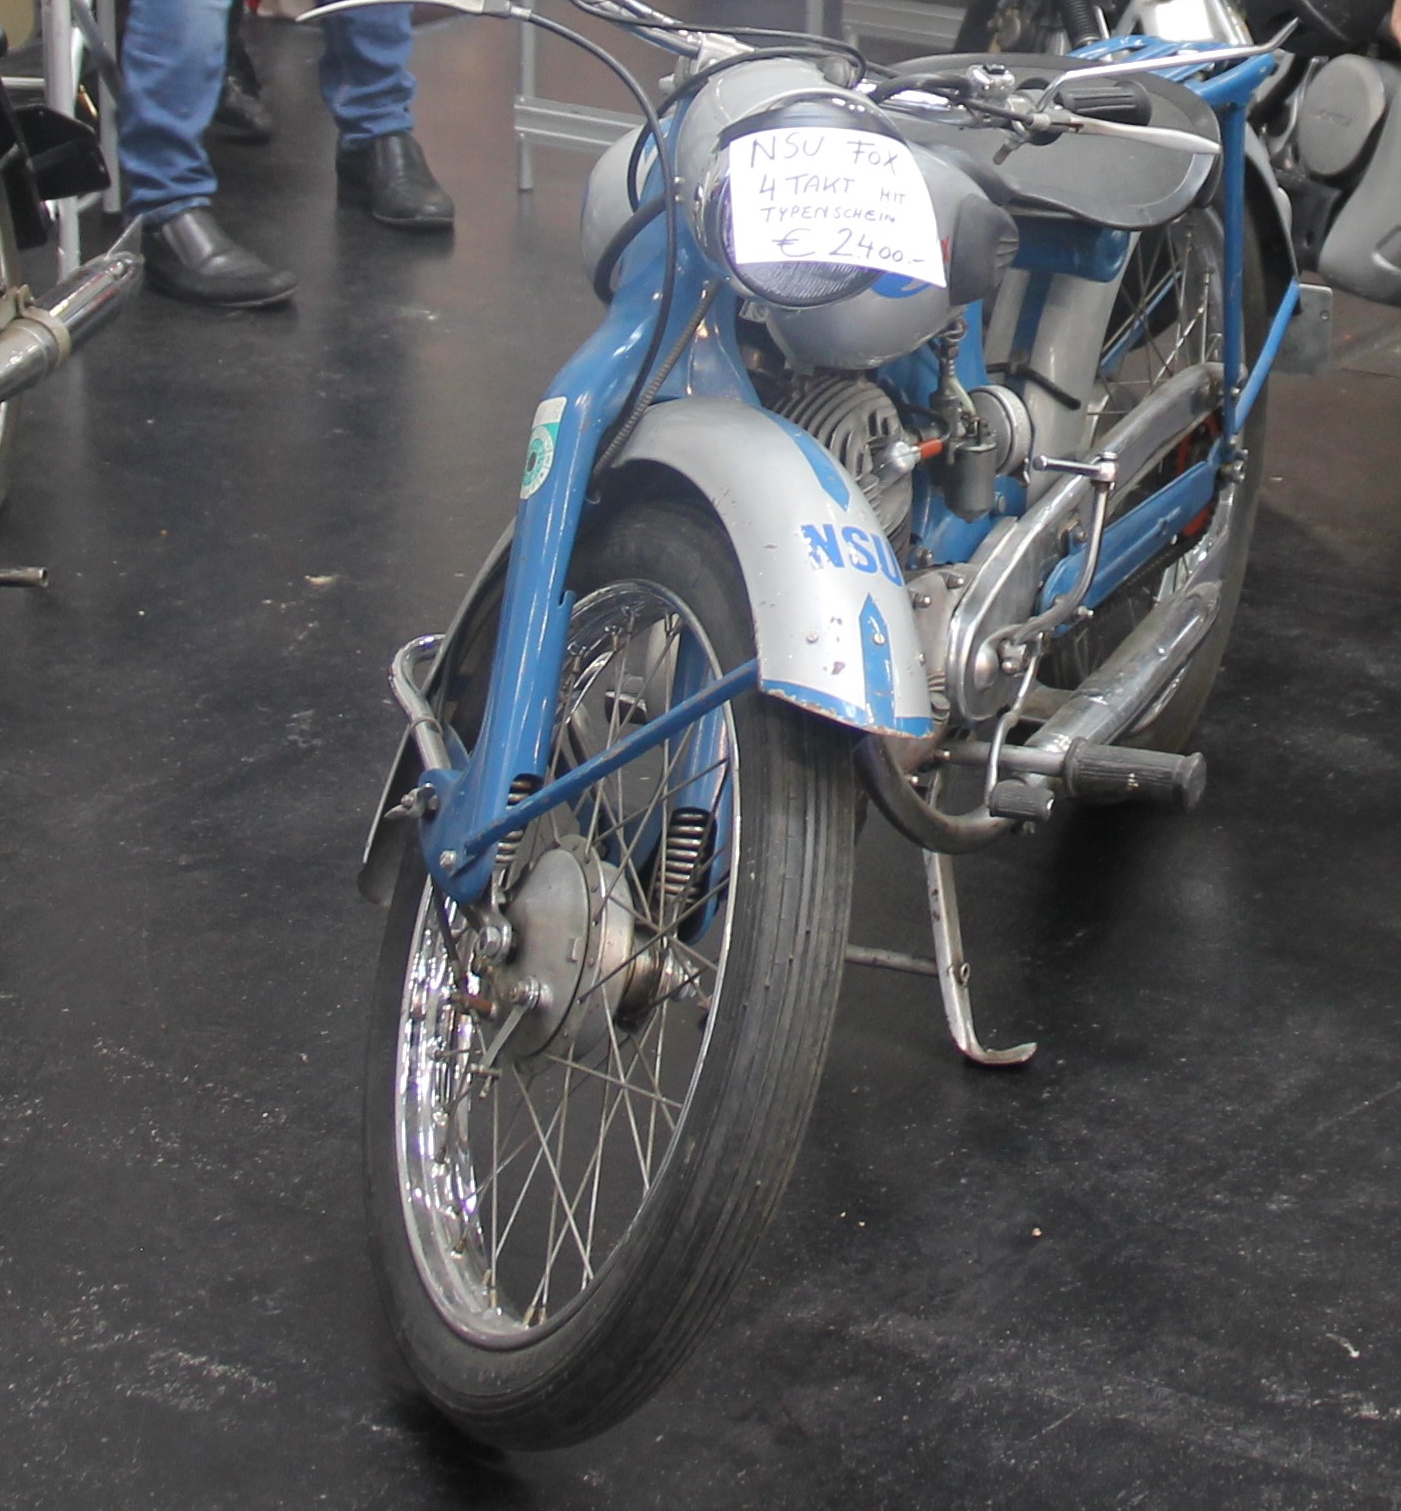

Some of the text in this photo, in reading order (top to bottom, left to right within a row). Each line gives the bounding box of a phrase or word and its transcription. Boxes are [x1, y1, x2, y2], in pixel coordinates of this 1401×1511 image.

[749, 131, 899, 176] NSU FOX
[758, 173, 777, 202] 4
[783, 172, 856, 196] TAKT
[770, 226, 817, 258] €
[800, 522, 906, 588] NSU
